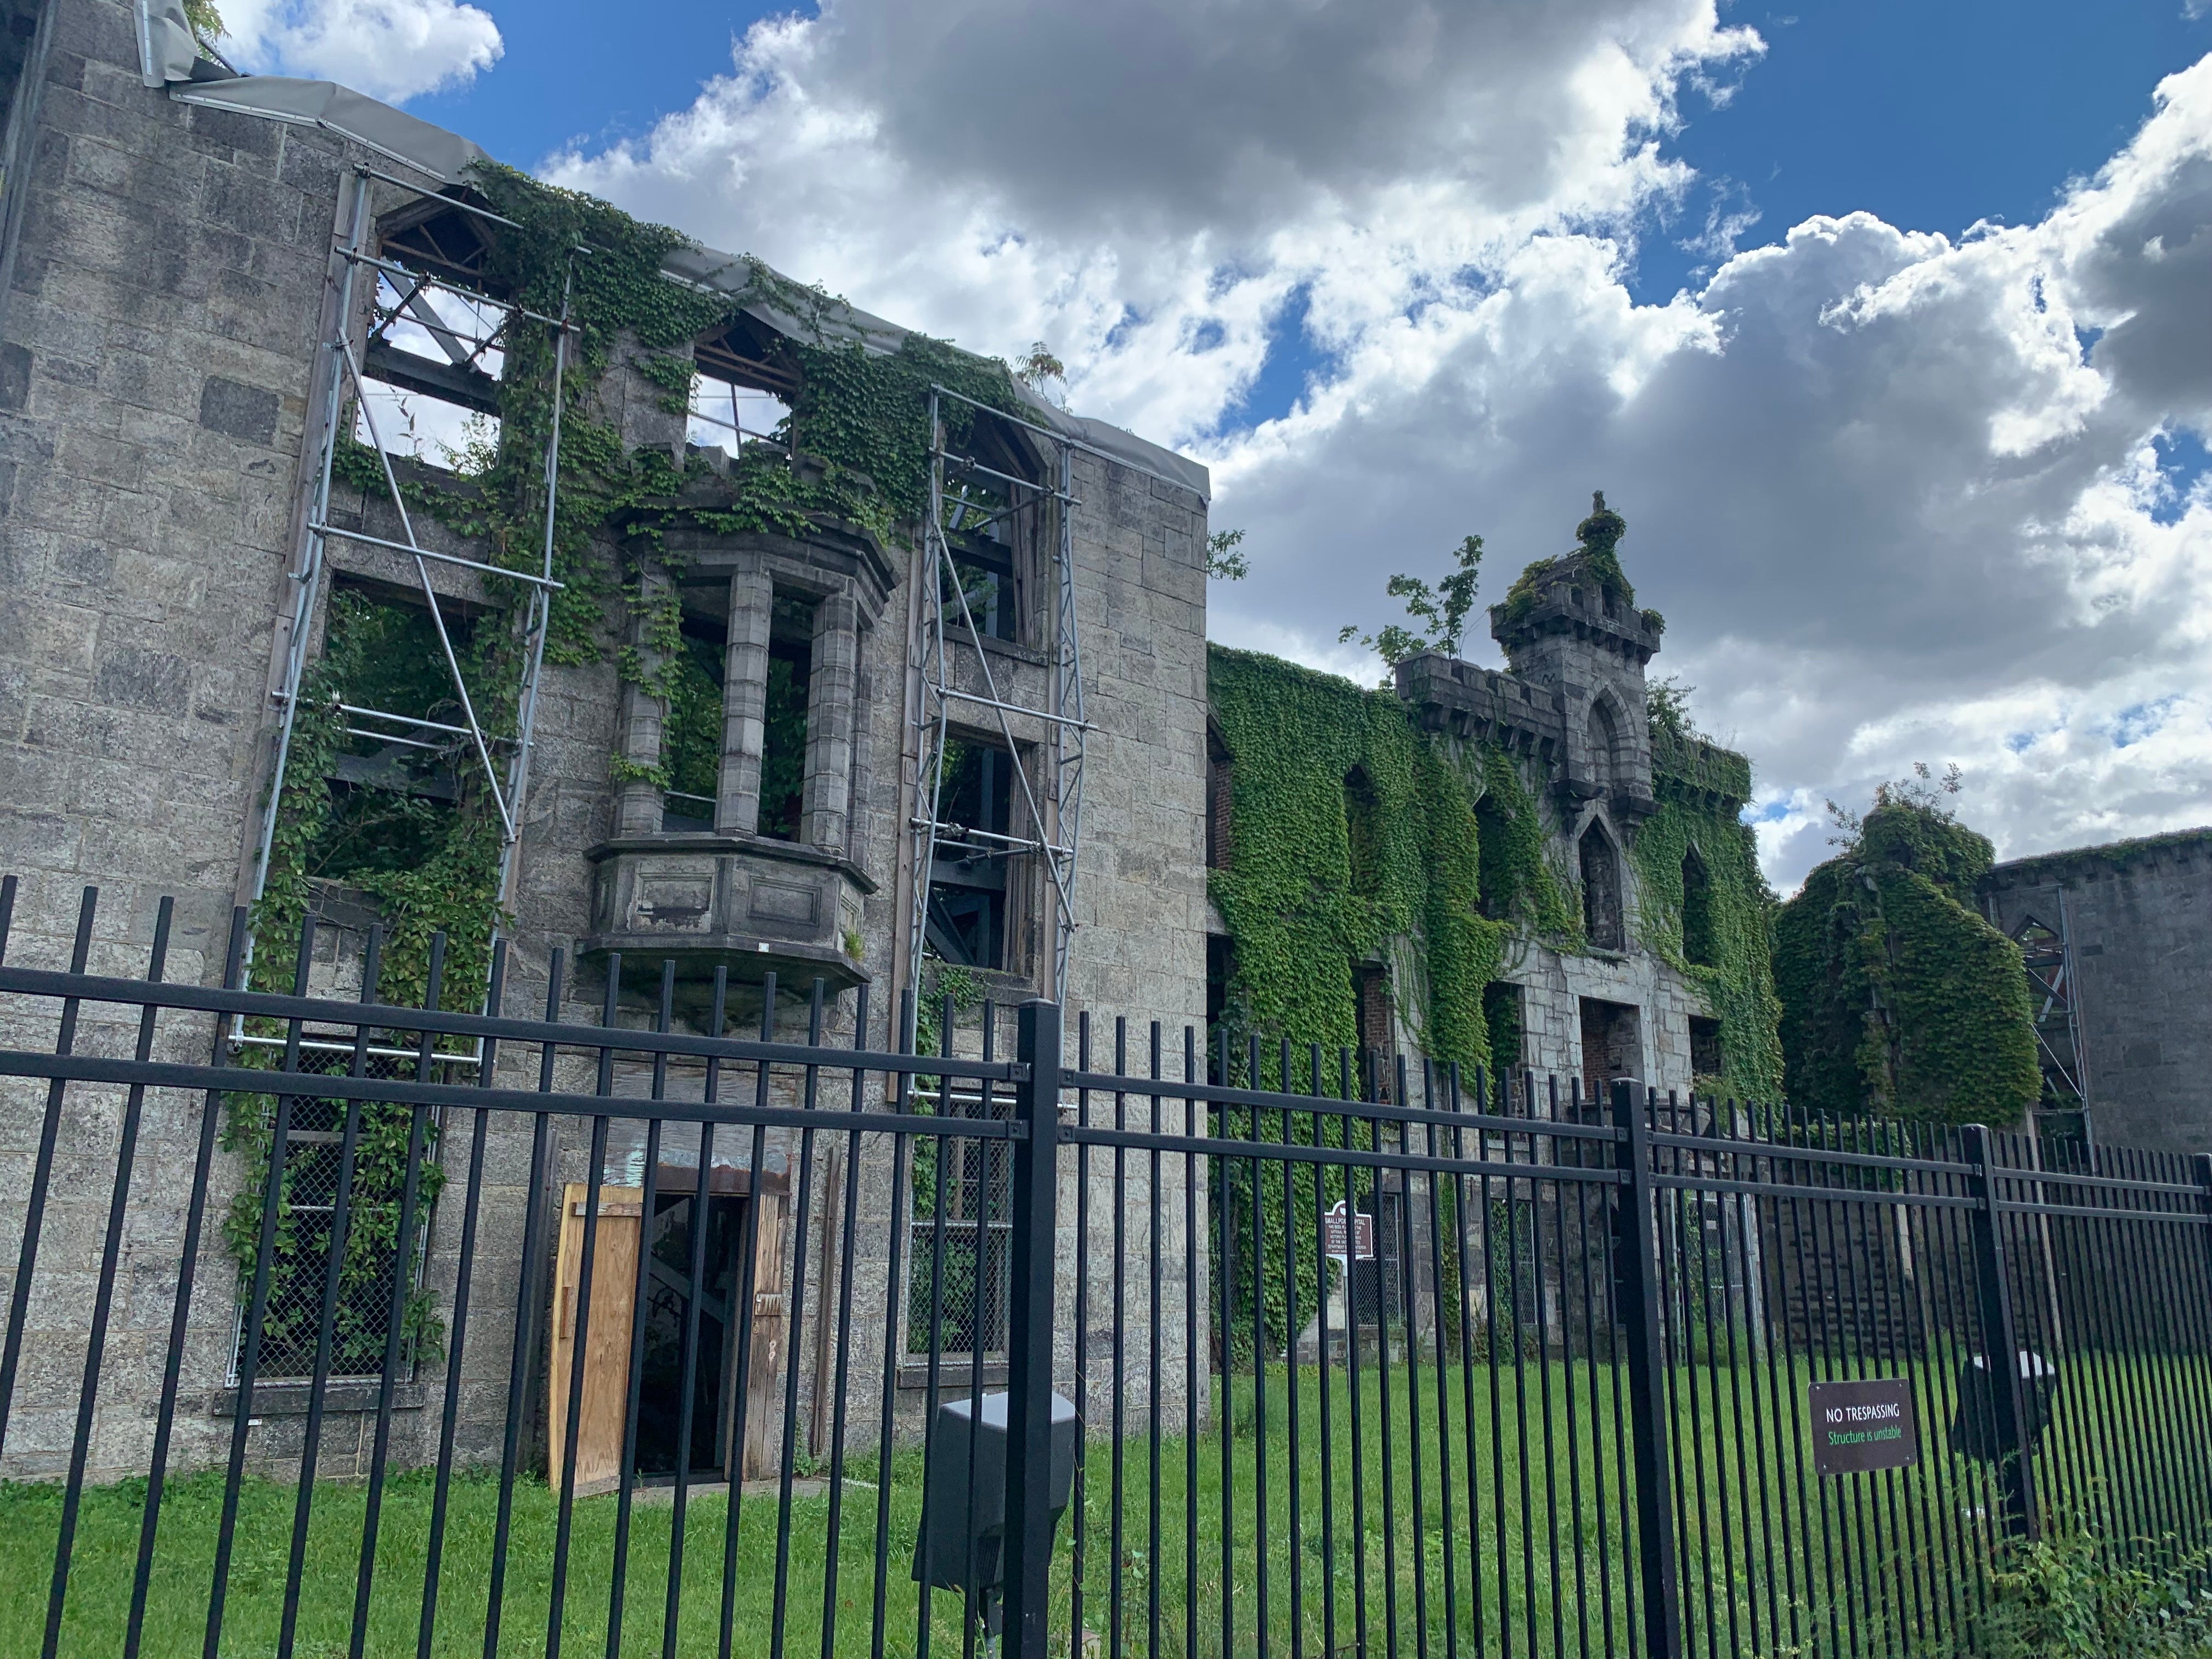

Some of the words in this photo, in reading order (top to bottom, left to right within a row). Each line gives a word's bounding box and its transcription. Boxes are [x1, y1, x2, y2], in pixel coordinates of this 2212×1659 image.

[1826, 1408, 1843, 1423] NO
[1846, 1403, 1900, 1421] TRESPASSING
[1828, 1430, 1865, 1446] Structure
[1866, 1429, 1873, 1442] is
[1874, 1425, 1902, 1441] unstable
